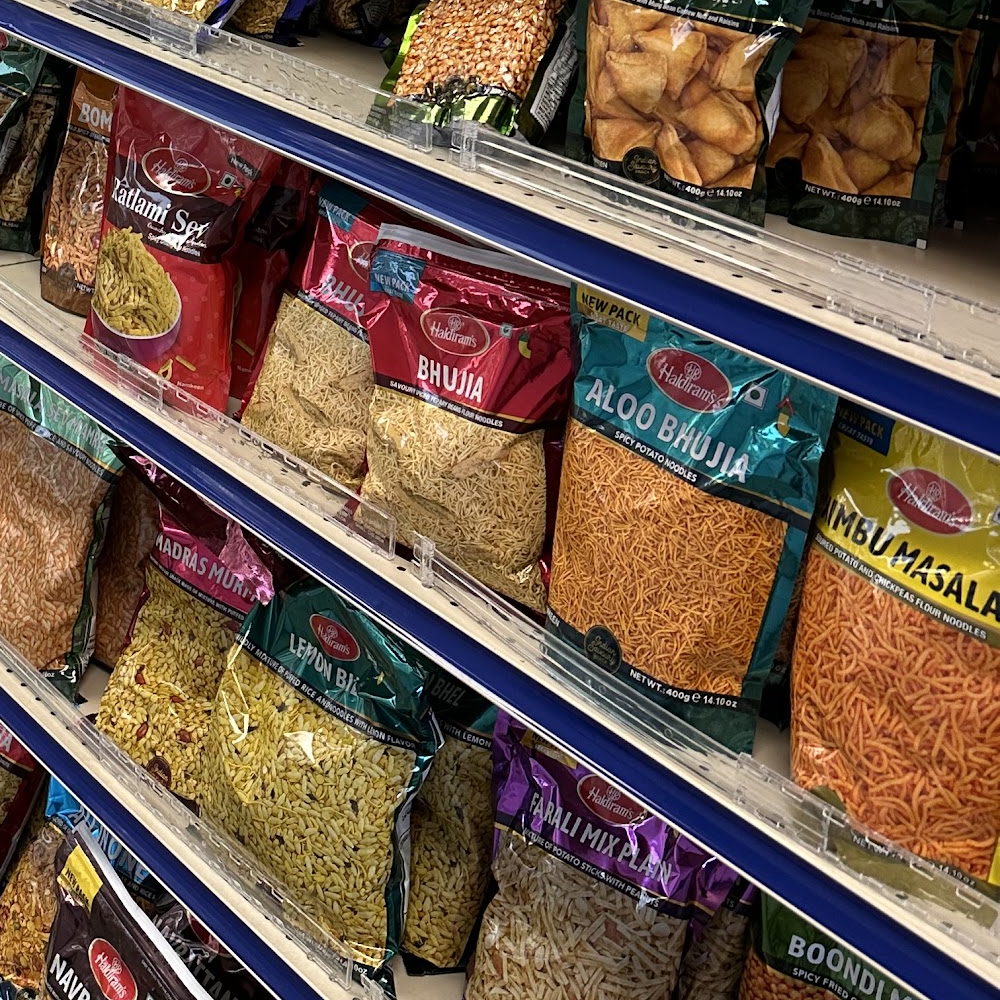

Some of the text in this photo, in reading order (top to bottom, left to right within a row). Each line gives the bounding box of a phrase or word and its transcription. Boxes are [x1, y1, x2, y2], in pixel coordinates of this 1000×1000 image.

[708, 13, 719, 23] and
[830, 12, 851, 23] Cashew
[852, 16, 864, 26] Nuts
[865, 19, 877, 28] and
[111, 176, 210, 239] Ratlami Sev
[685, 185, 706, 197] 400g
[804, 184, 821, 194] NET
[840, 195, 862, 205] 400g
[333, 204, 351, 221] PACK
[374, 272, 410, 292] NEW PACK
[582, 292, 641, 327] NEW PACK
[429, 320, 478, 348] Haldiram's
[417, 354, 484, 403] BHUJIA
[659, 364, 717, 405] Haldiram's
[46, 403, 70, 425] SEV
[390, 380, 416, 394] SAVOURY
[474, 413, 504, 428] NOODLES
[585, 378, 750, 484] ALOO BHUJIA
[858, 413, 884, 439] PACK
[614, 430, 698, 483] SPICY POTATO NOODLES
[833, 545, 988, 640] POTATO AND CHICKPEAS FLOUR NOODLES
[889, 541, 1000, 622] MASALA
[255, 648, 279, 670] MIXTURE
[277, 665, 285, 675] OF
[284, 671, 301, 687] PUFFED
[301, 684, 317, 698] RICE
[354, 719, 367, 731] WITH
[430, 678, 466, 707] BHEL
[630, 668, 646, 683] NET
[666, 689, 690, 703] 400g
[443, 721, 492, 748] WITH LEMON
[587, 786, 634, 820] Haldiram's
[529, 791, 672, 886] FARALI MIX PLAIN
[544, 840, 553, 849] OF
[552, 845, 581, 866] POTATO
[604, 874, 625, 890] WITH
[793, 967, 849, 1000] SPICY FRIED
